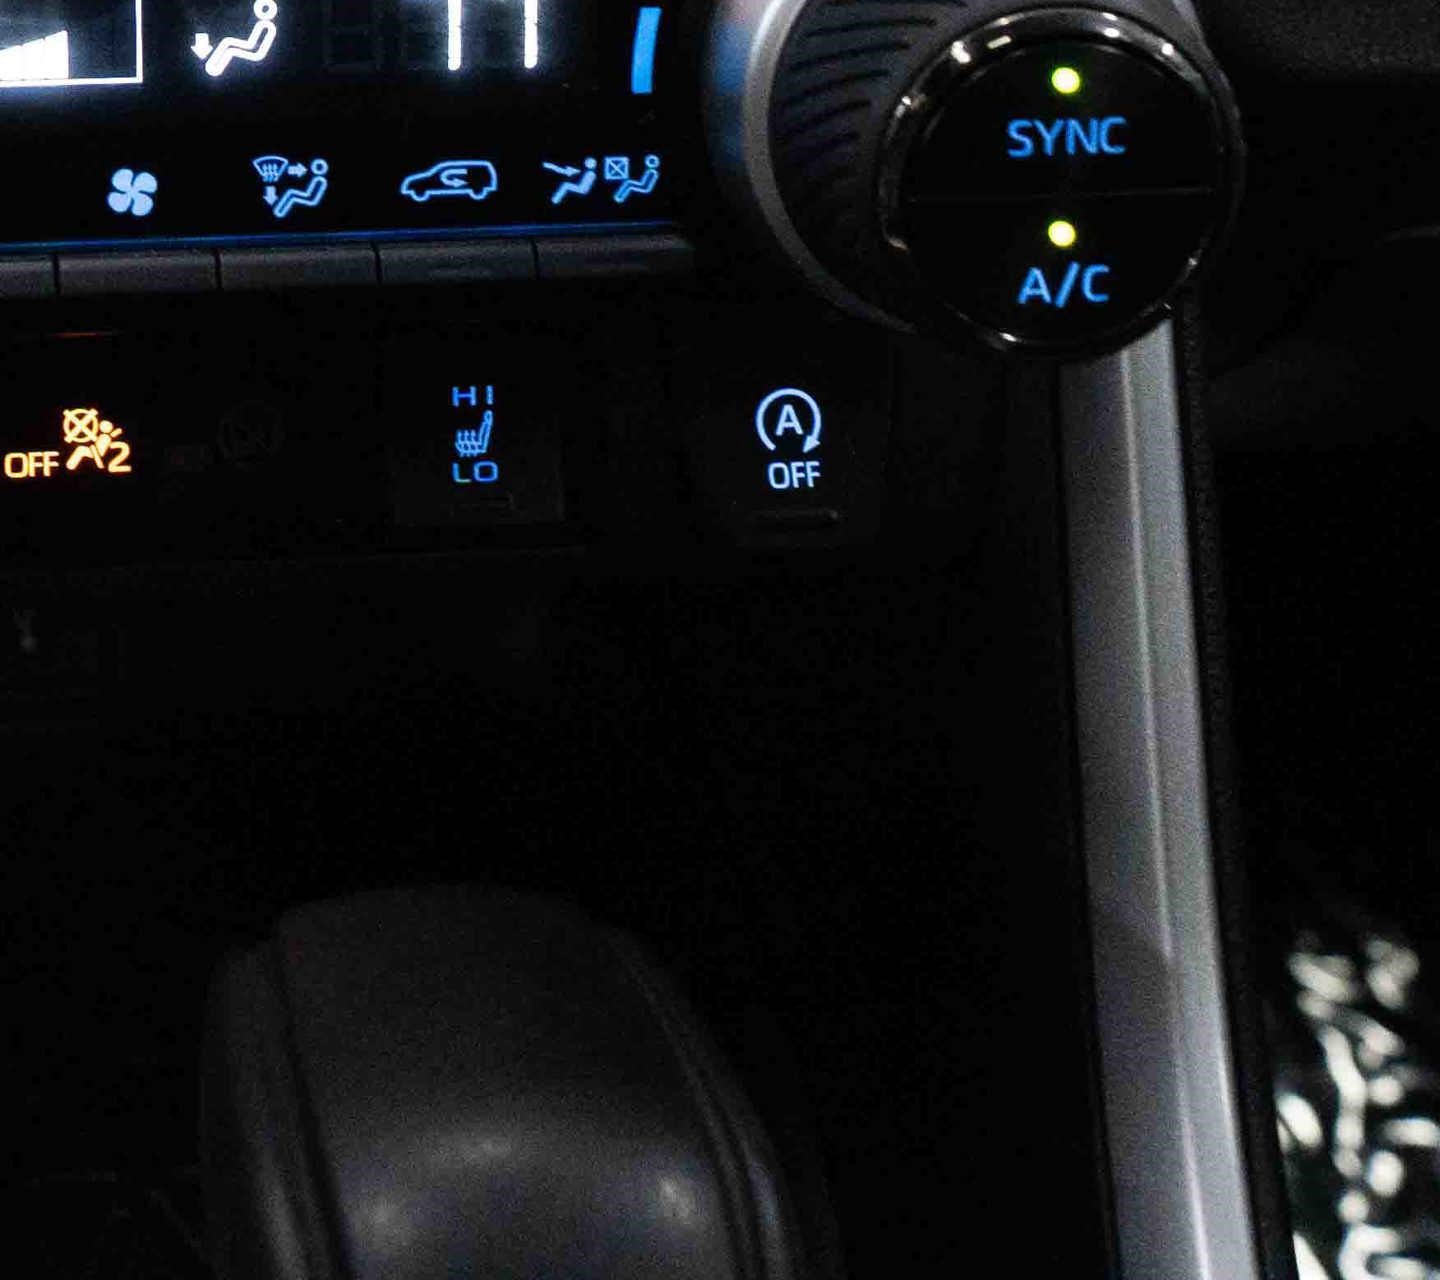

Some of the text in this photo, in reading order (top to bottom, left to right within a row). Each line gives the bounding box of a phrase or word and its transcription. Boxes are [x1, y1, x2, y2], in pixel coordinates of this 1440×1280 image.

[1007, 116, 1125, 158] SYNC
[1018, 261, 1109, 308] A/C
[452, 385, 494, 407] HI
[775, 403, 804, 436] A
[3, 450, 59, 479] OFF
[452, 460, 499, 483] LO
[767, 460, 821, 490] OFF
